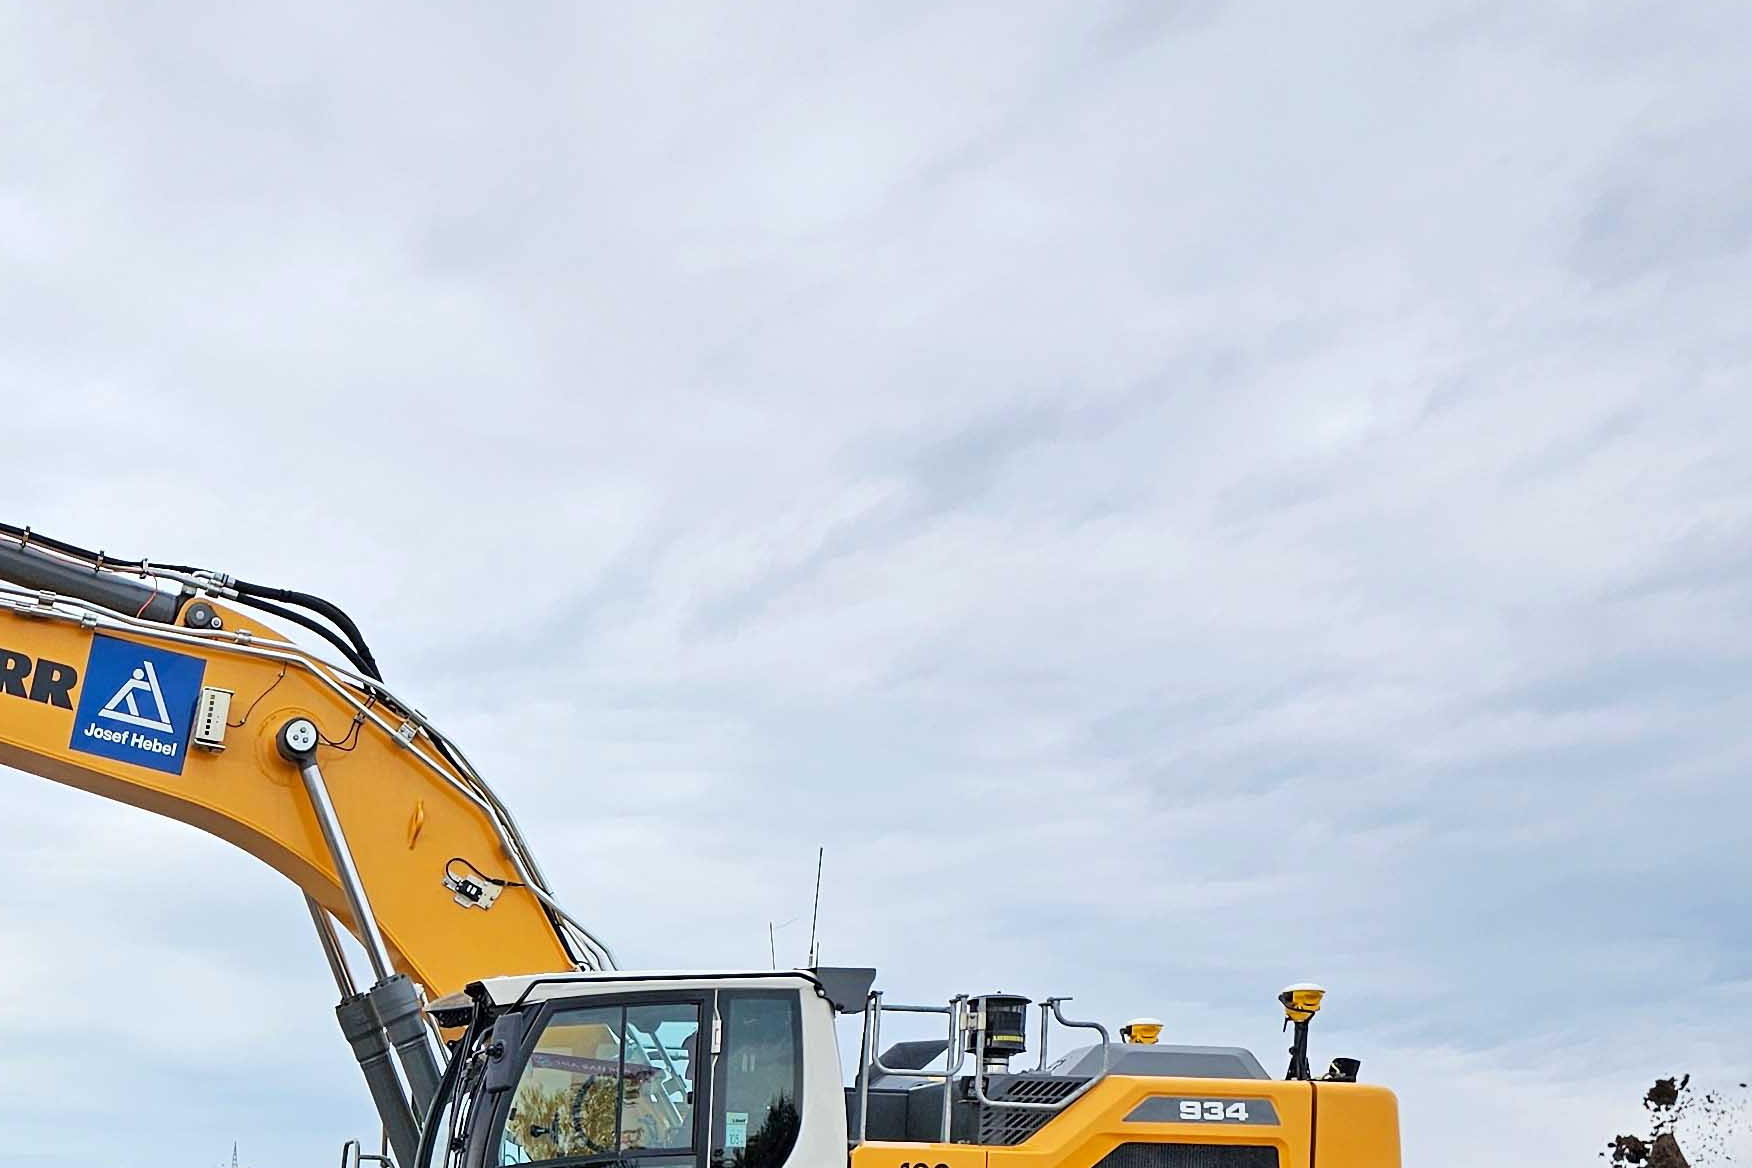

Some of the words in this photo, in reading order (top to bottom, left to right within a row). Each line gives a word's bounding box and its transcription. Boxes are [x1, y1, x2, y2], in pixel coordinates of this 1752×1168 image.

[84, 722, 130, 745] Josef
[130, 732, 178, 757] Hebel
[1179, 1100, 1249, 1121] 934
